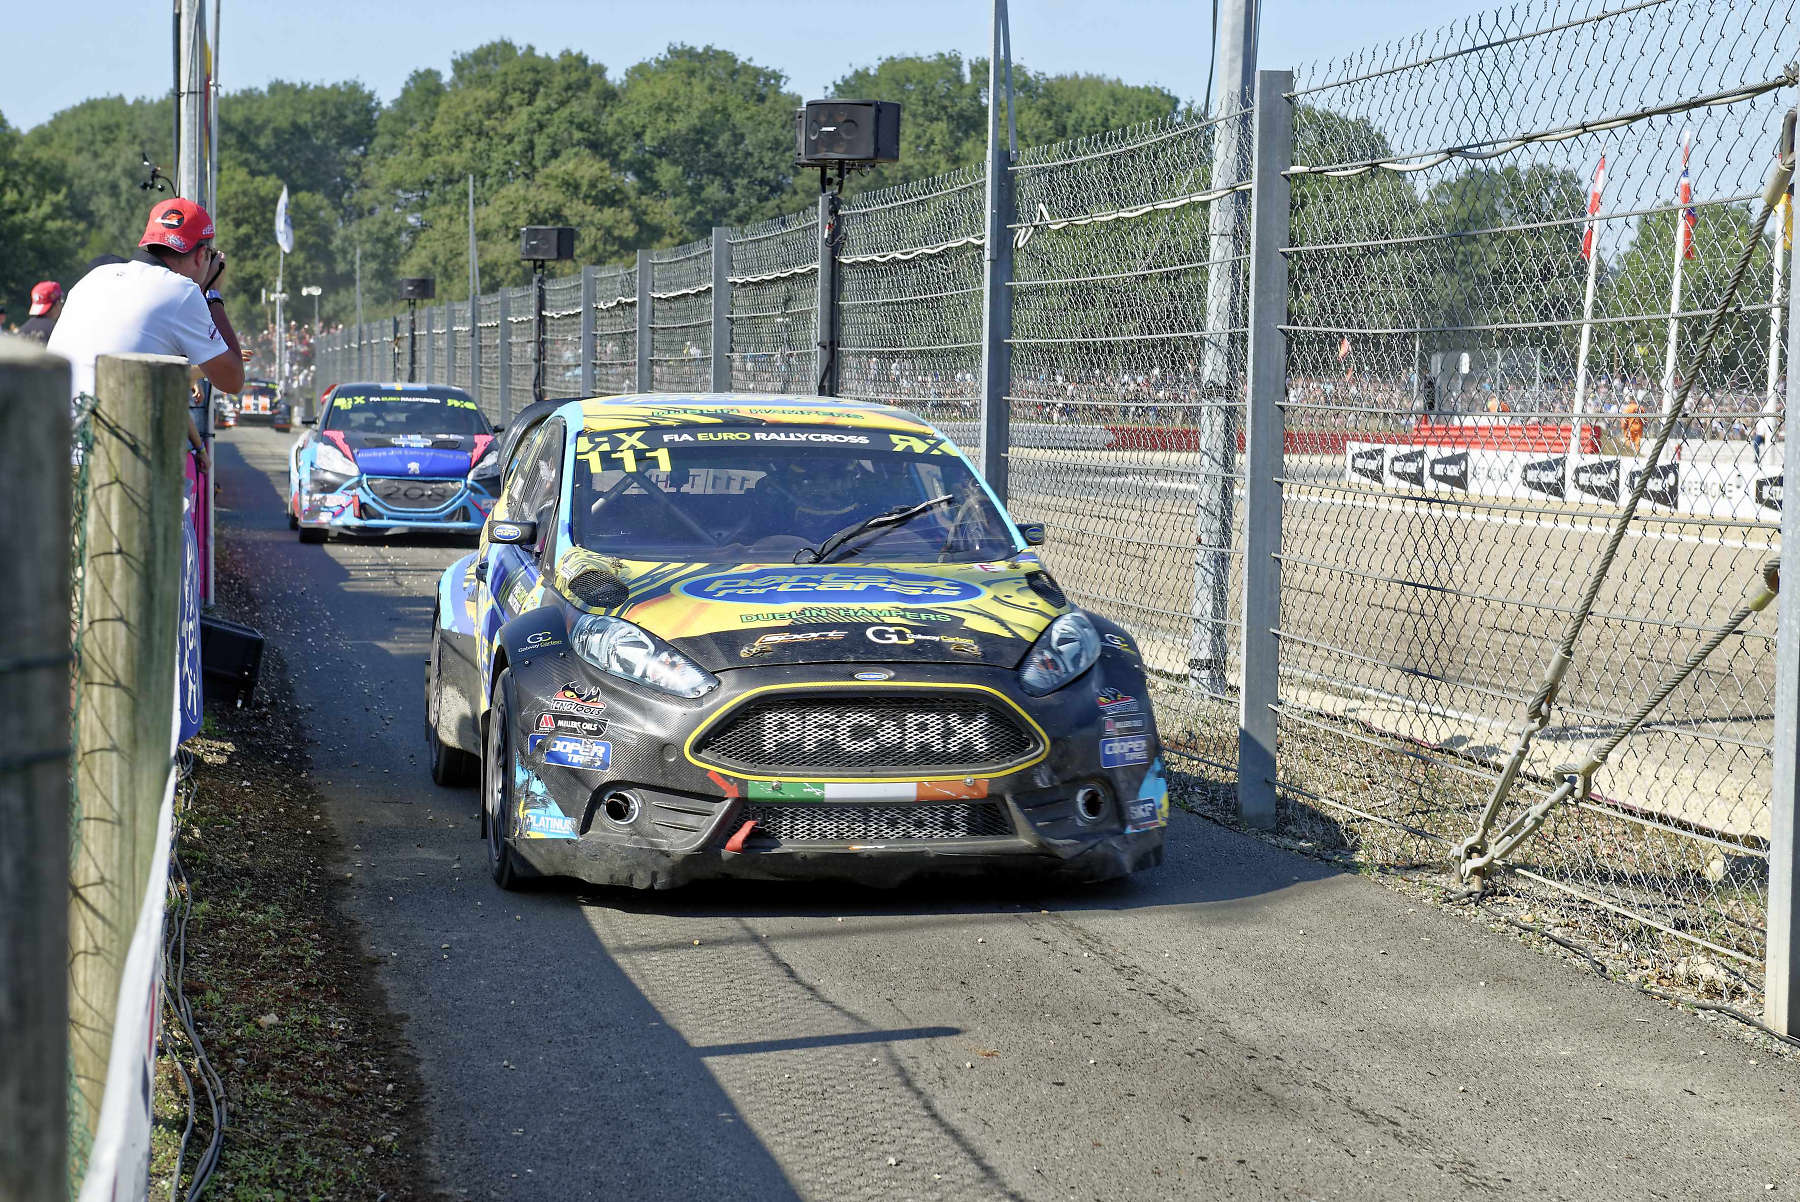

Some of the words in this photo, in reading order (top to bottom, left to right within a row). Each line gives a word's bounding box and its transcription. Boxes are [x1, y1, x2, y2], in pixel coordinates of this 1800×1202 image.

[662, 433, 695, 443] FIA
[697, 432, 751, 442] EURO
[754, 432, 870, 444] RALLYCROSS
[576, 448, 672, 474] 111
[740, 610, 827, 624] DUBLIN
[838, 609, 952, 622] HAMPERS
[582, 723, 599, 731] OILS
[1129, 802, 1155, 822] SKF
